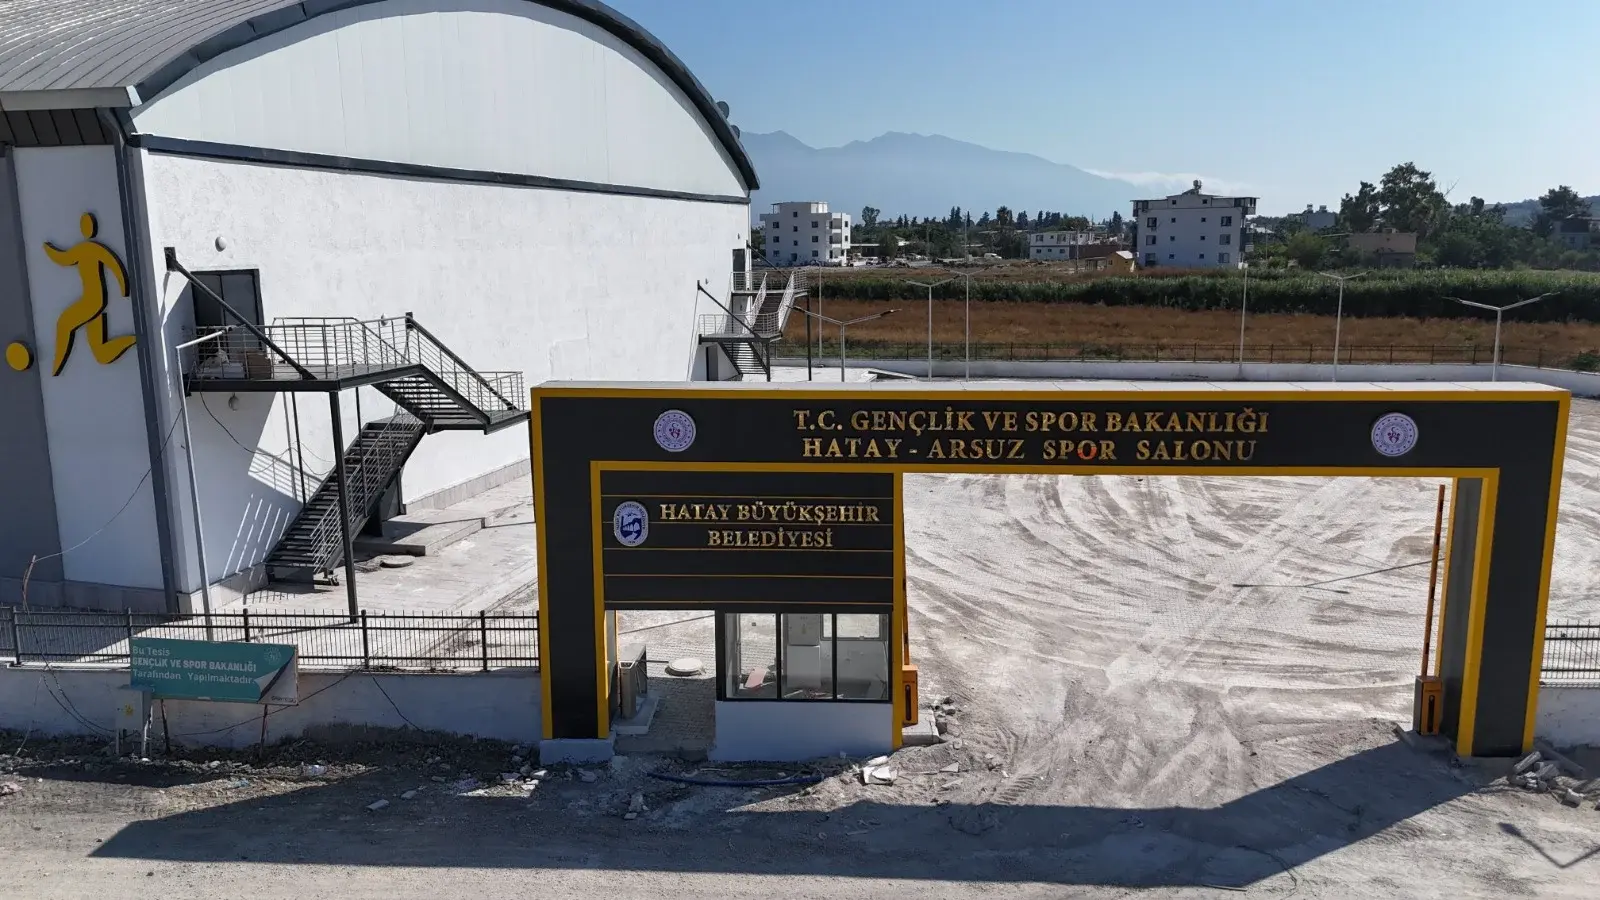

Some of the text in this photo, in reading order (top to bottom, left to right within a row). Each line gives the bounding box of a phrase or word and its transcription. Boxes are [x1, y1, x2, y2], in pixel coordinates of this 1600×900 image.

[793, 406, 1269, 436] T.C. GENÇLİK VE SPOR BAKANLIĞI
[802, 437, 902, 459] HATAY
[926, 438, 1025, 460] ARSUZ
[1042, 439, 1117, 461] SPOR
[1135, 439, 1257, 461] SALONU
[659, 501, 880, 525] HATAY BÜYÜKŞEHİR
[708, 527, 833, 548] BELEDİYESİ
[132, 645, 171, 657] Bu Tesis
[133, 669, 182, 680] Tarafından
[171, 659, 182, 668] VE
[183, 660, 207, 670] SPOR
[209, 661, 257, 673] BAKANLIĞI
